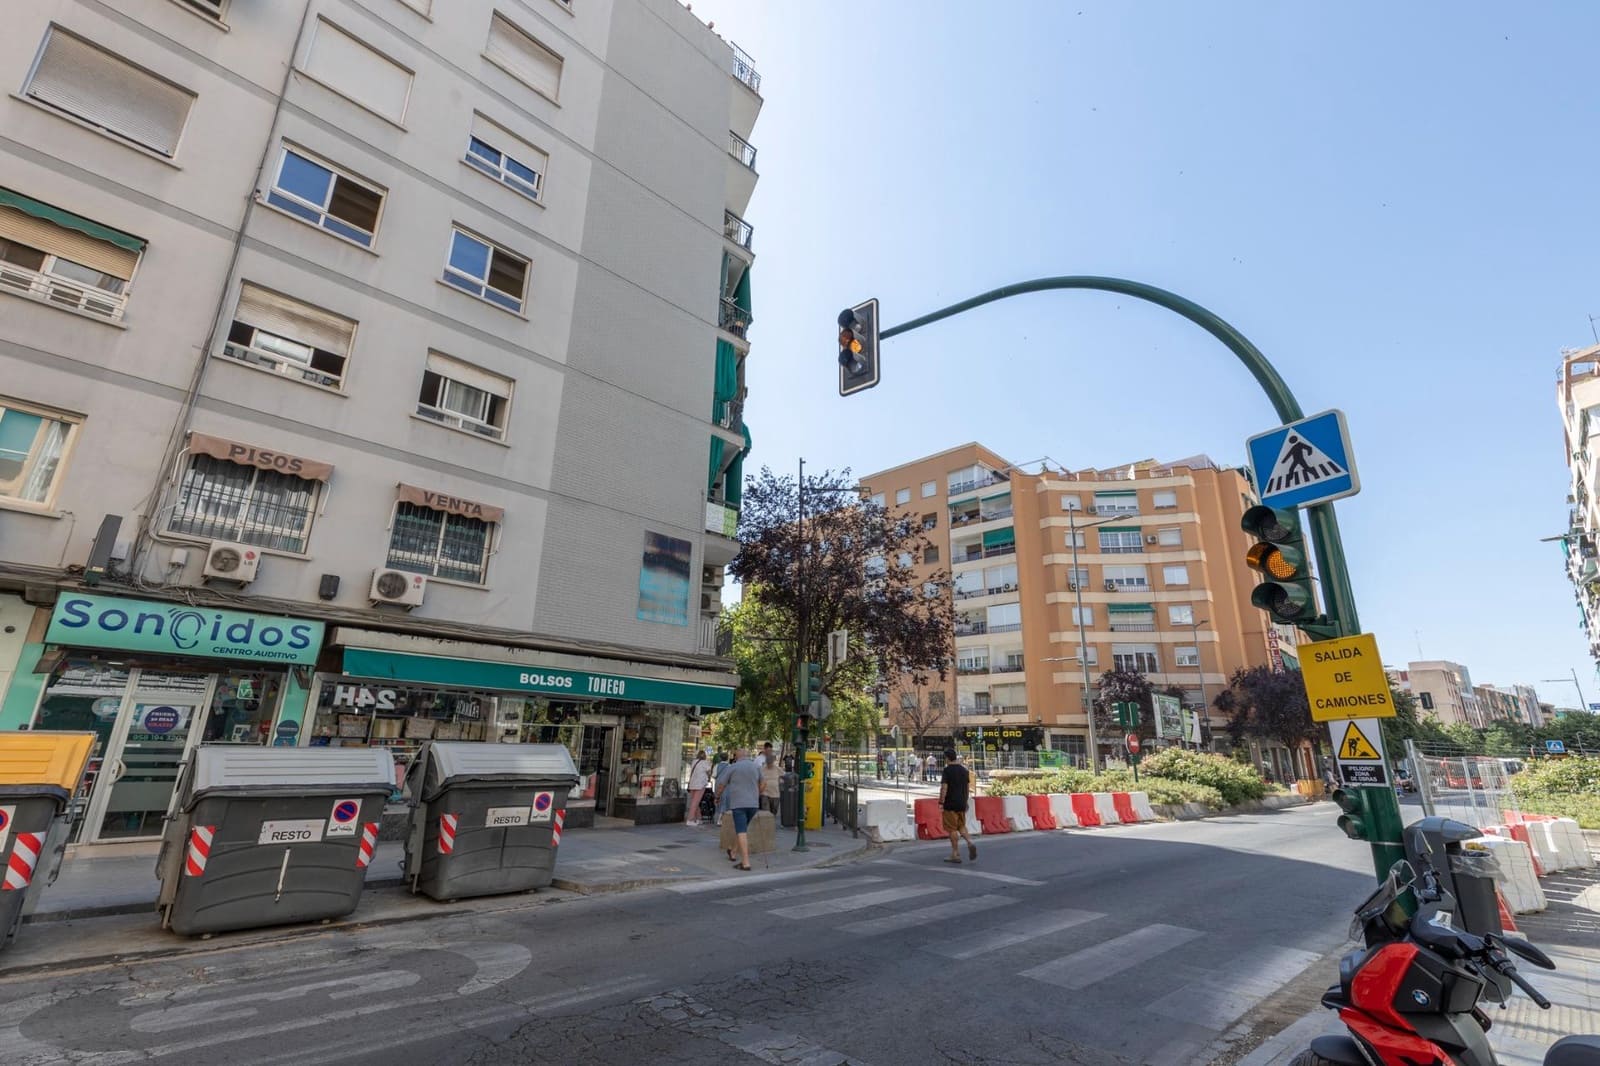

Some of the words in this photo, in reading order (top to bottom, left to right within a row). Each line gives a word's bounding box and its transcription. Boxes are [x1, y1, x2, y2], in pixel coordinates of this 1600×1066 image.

[228, 443, 303, 472] PISOS
[423, 491, 483, 516] VENTA
[212, 646, 253, 656] CENTRO
[254, 650, 298, 660] AUDITIVO
[1314, 647, 1362, 663] SALIDA
[519, 673, 573, 688] BOLSOS
[1334, 671, 1353, 683] DE
[1315, 693, 1386, 709] CAMIONES
[493, 815, 521, 825] RESTO
[271, 830, 312, 841] RESTO
